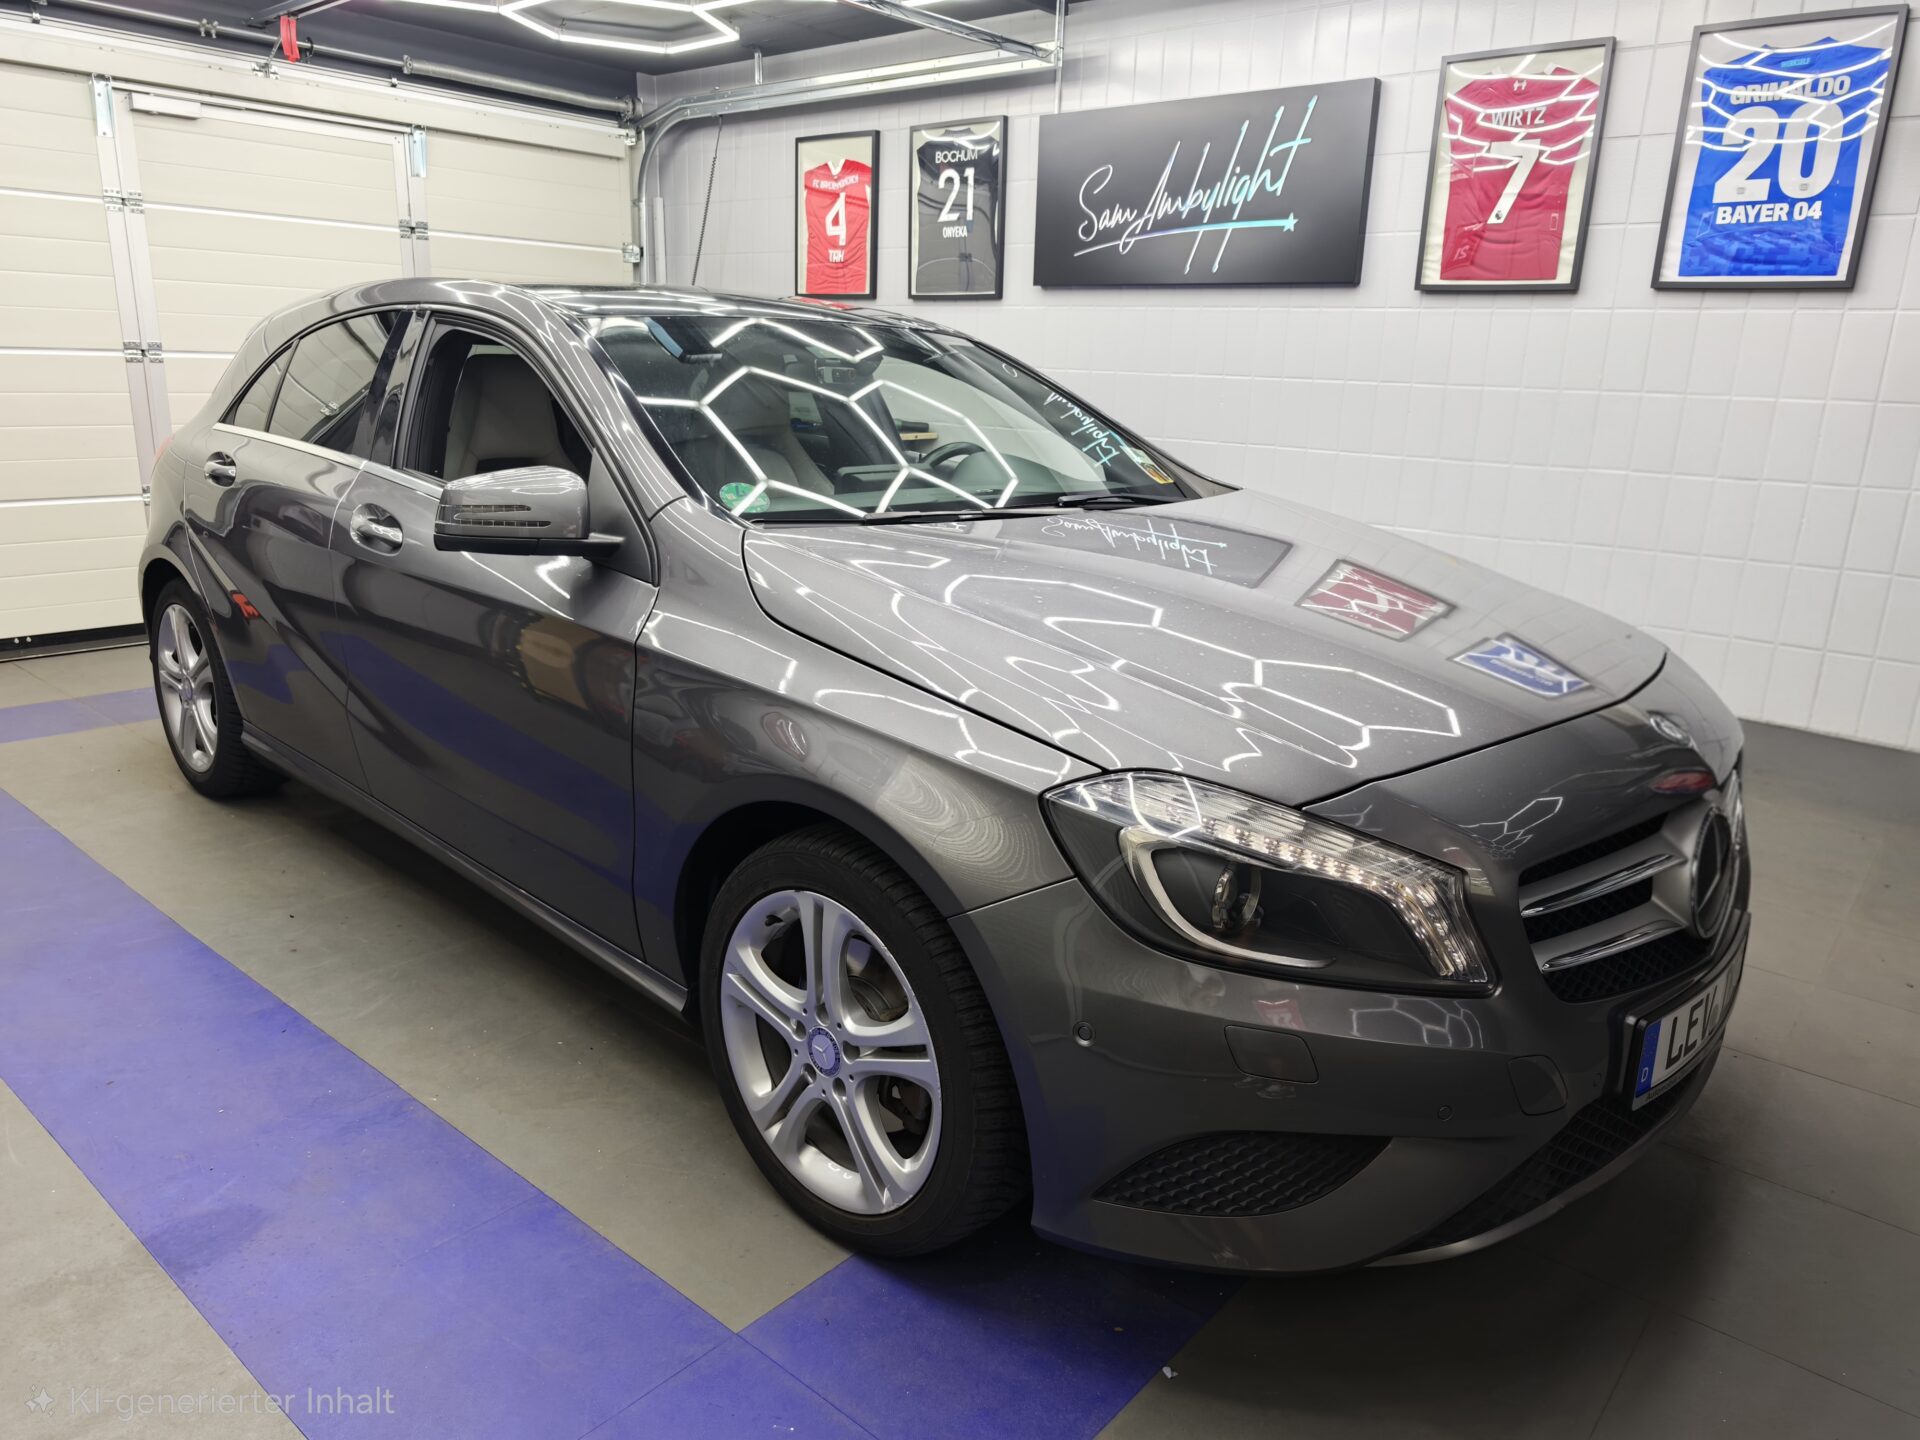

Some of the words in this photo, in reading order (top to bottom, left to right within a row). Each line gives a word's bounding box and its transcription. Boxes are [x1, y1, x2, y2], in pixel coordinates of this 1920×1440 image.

[1730, 75, 1851, 105] GRIMALDO
[1491, 106, 1547, 127] WIRTZ
[935, 149, 978, 164] BOCHUM
[1712, 101, 1844, 204] 20
[937, 167, 975, 223] 21
[1487, 138, 1541, 224] 7
[825, 191, 847, 246] 4
[1078, 164, 1137, 242] Sam
[1715, 202, 1790, 225] BAYER
[1792, 201, 1822, 221] 04
[942, 225, 968, 239] ONYEKA
[828, 249, 845, 263] TAH
[1641, 1066, 1649, 1083] D
[1665, 985, 1718, 1070] LEV
